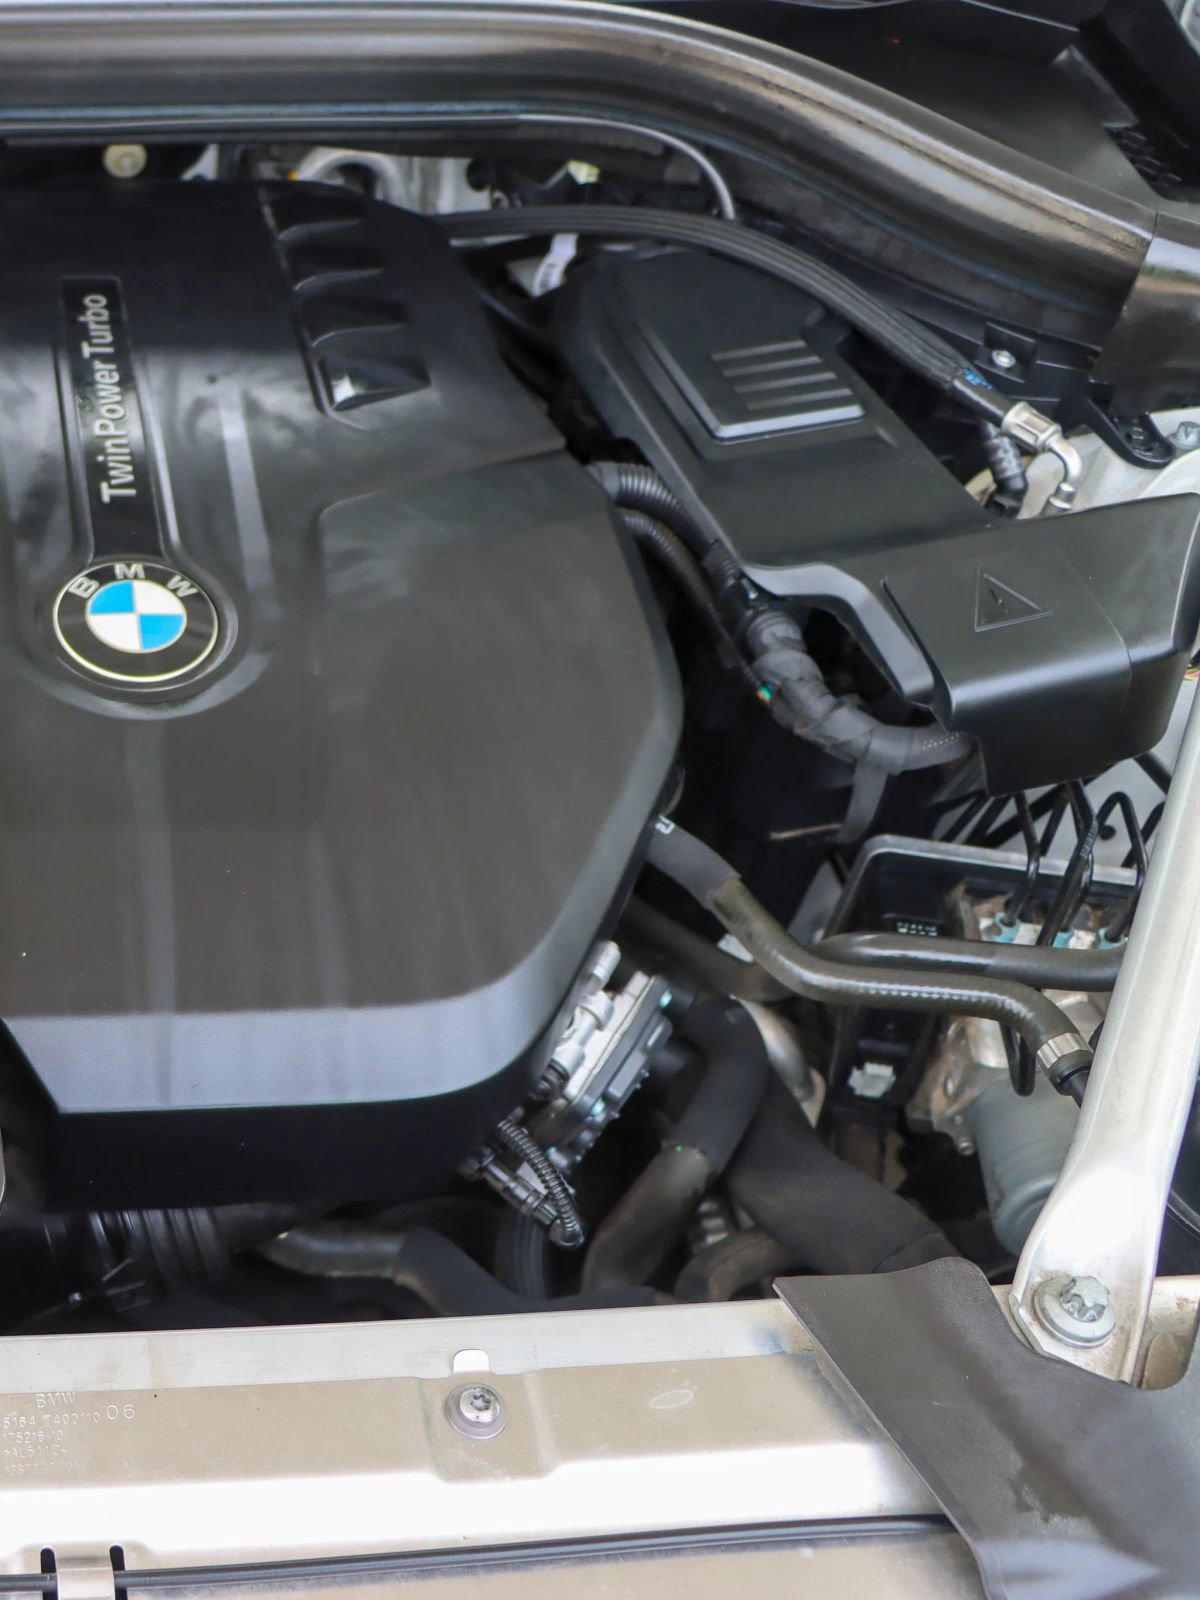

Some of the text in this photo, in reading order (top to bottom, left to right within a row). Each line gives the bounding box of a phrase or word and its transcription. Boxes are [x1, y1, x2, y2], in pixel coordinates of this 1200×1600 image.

[78, 294, 136, 503] TwinPower Turbo
[68, 563, 198, 598] BMW
[36, 1391, 76, 1408] BMW
